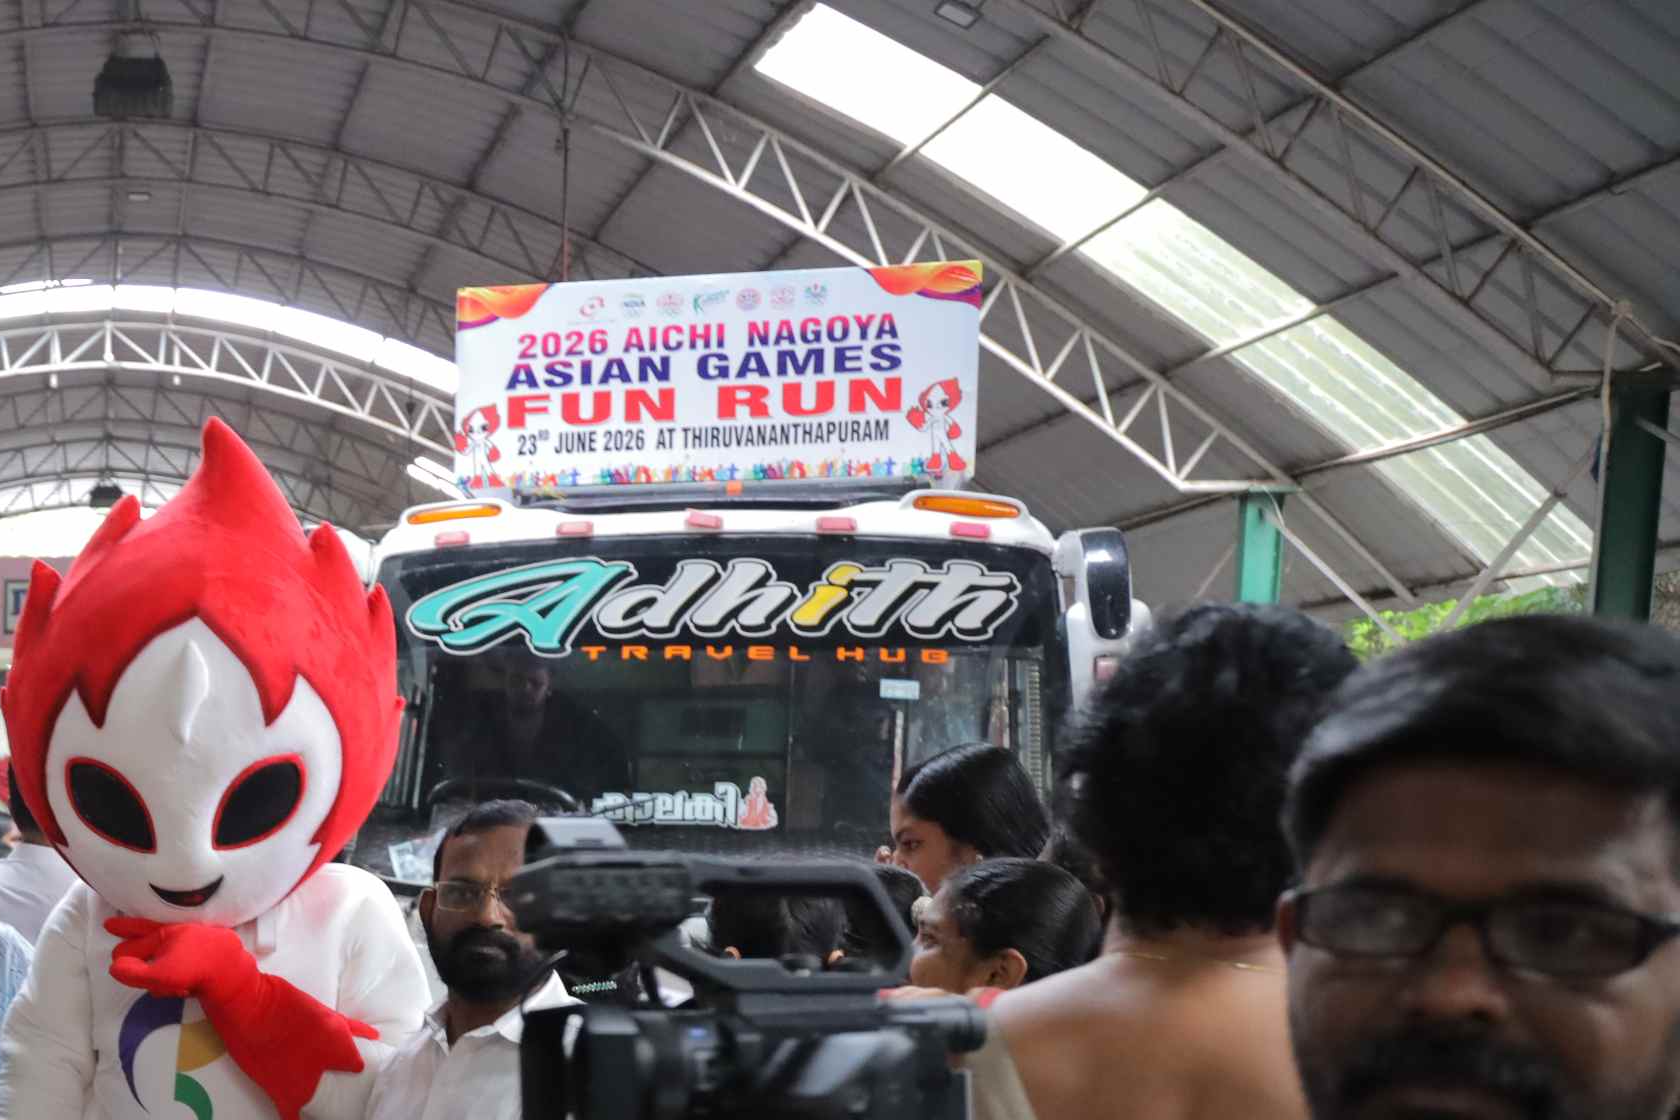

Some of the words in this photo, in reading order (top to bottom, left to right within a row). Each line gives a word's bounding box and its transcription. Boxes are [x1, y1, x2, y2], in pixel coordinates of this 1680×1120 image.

[518, 328, 608, 359] 2026
[623, 323, 726, 354] AICHI
[747, 312, 899, 347] NAGOYA
[506, 355, 672, 391] ASIAN
[697, 342, 903, 381] GAMES
[506, 386, 676, 429] FUN
[716, 377, 903, 420] RUN
[555, 428, 597, 452] JUNE
[603, 425, 646, 450] 2026
[655, 426, 676, 449] AT
[681, 418, 890, 449] THIRUVANANTHAPURAM
[406, 556, 1023, 658] Adhith
[581, 645, 810, 663] TRAVEL
[836, 647, 950, 664] HUB
